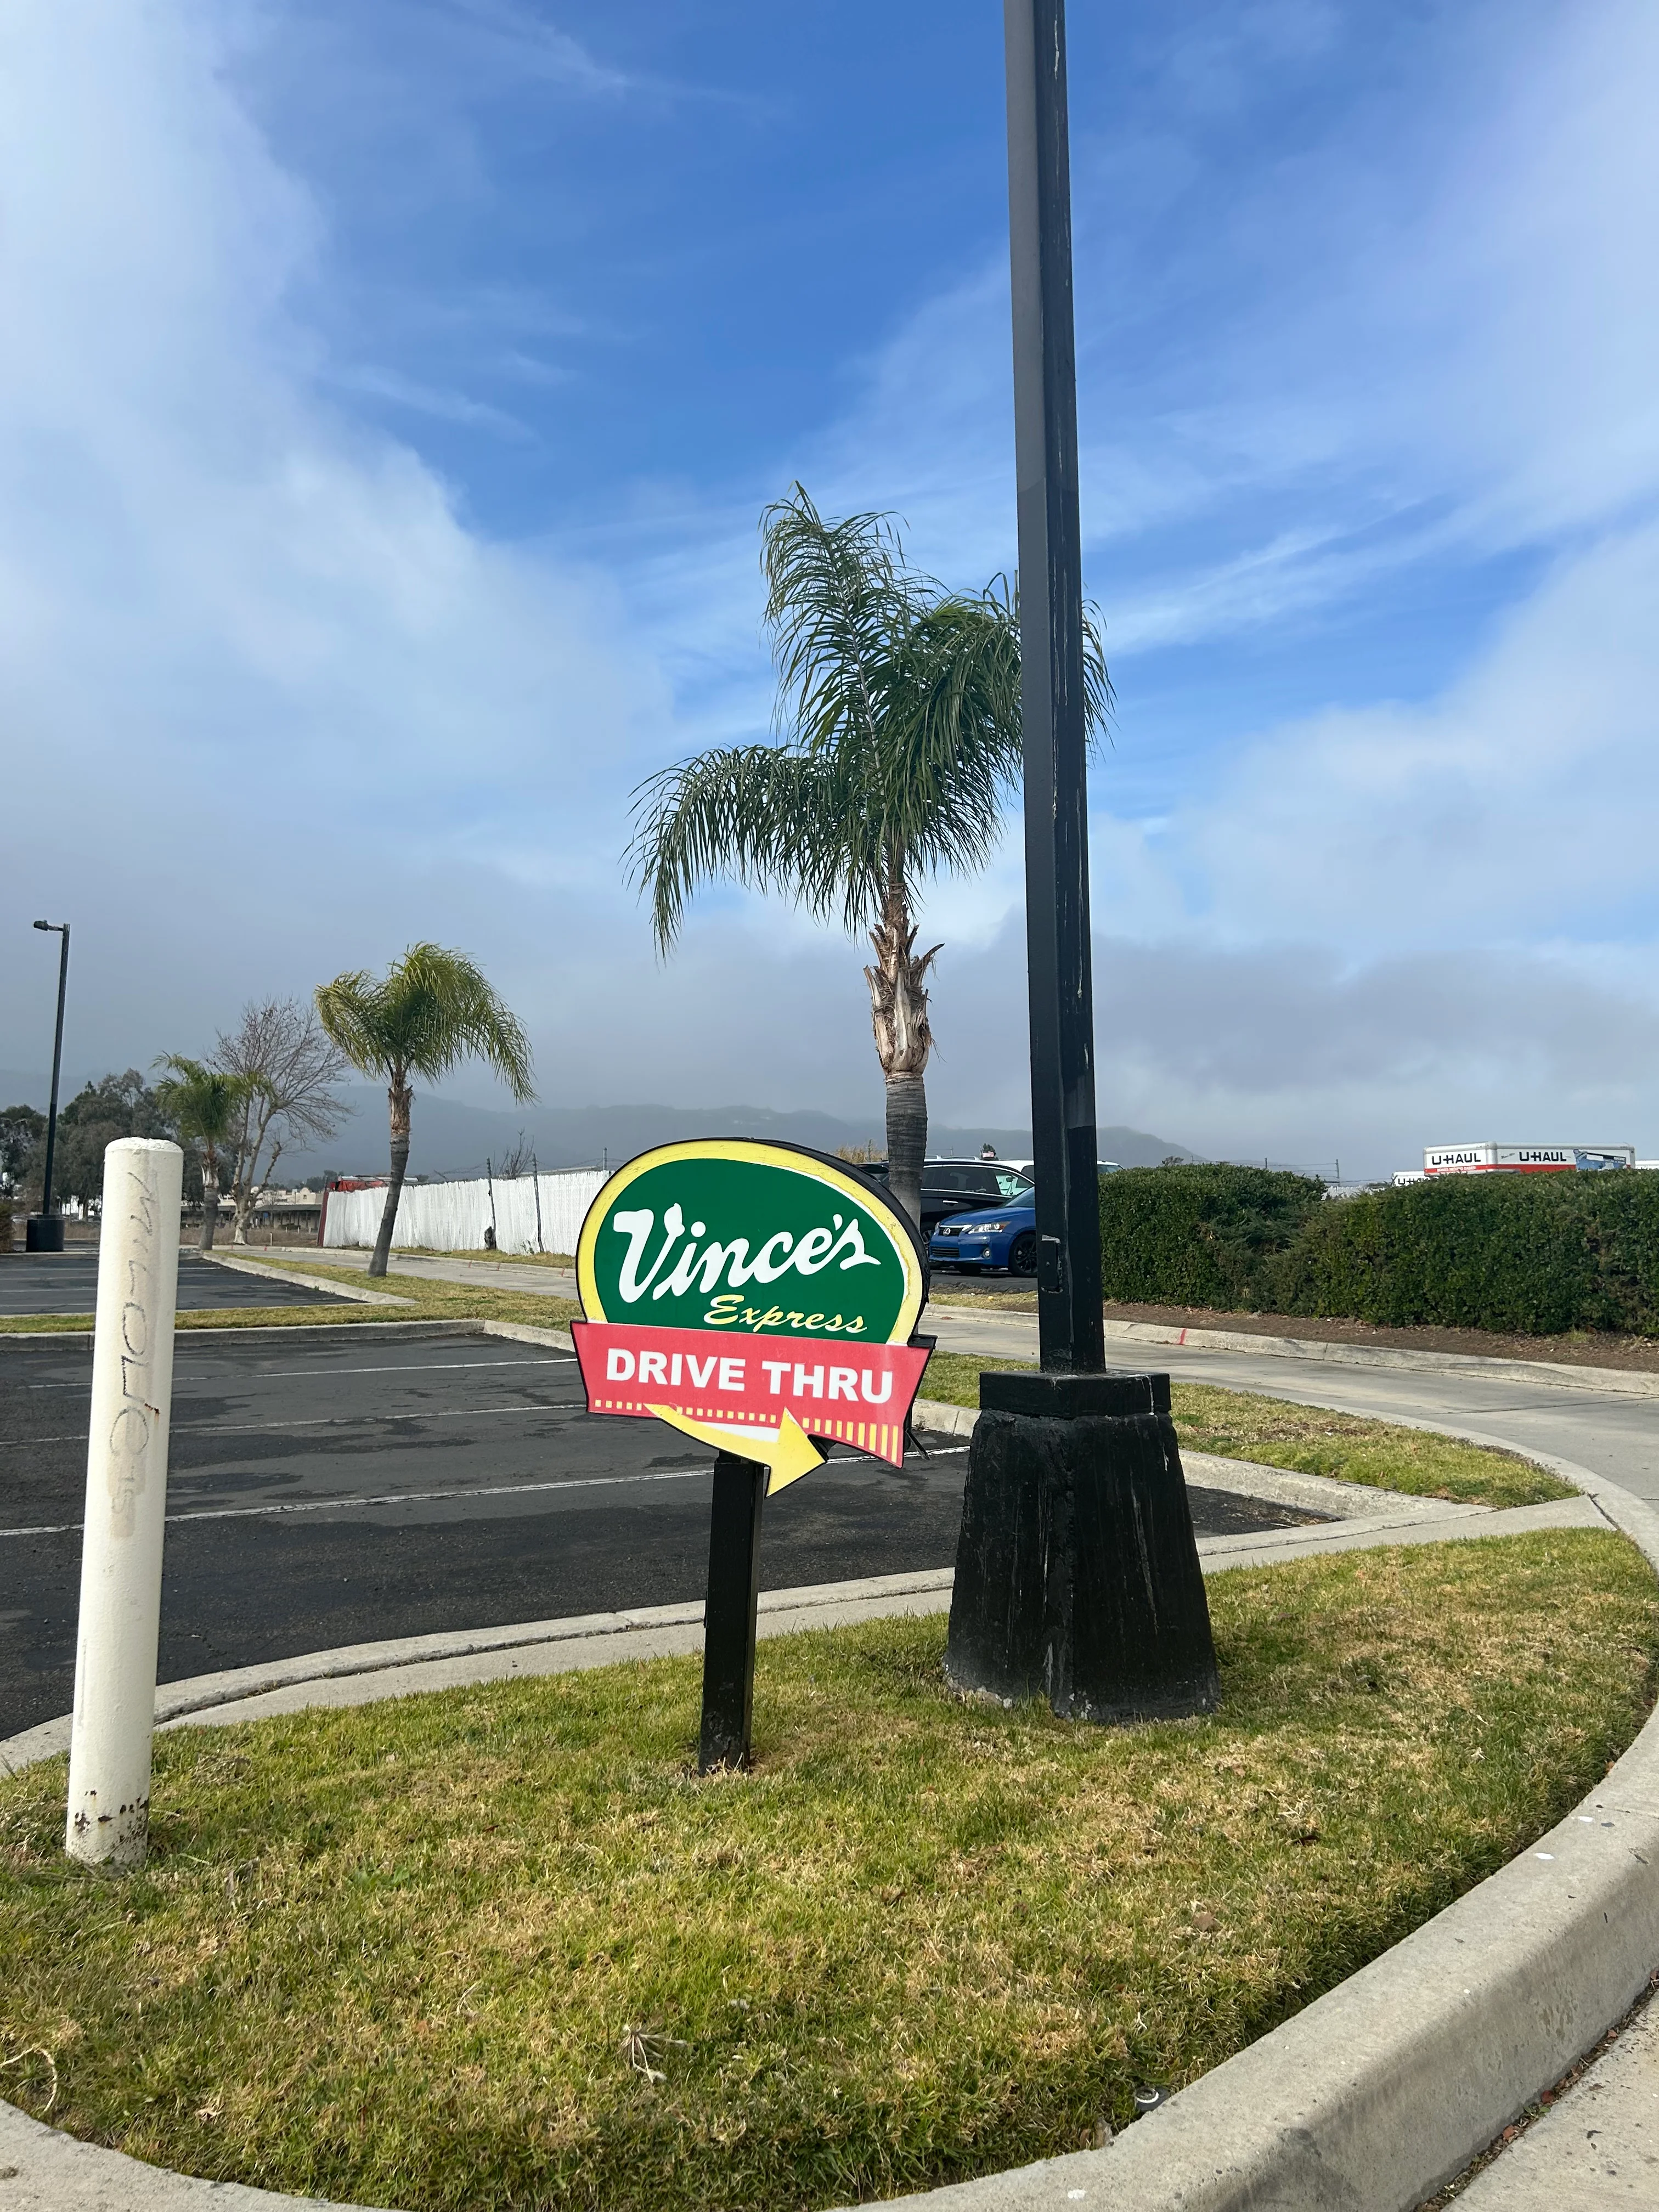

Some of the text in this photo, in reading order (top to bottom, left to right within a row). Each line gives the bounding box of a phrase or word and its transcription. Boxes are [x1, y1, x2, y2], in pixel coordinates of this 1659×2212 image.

[613, 1203, 882, 1304] Vince's
[703, 1294, 867, 1333] Express
[606, 1347, 893, 1404] DRIVE THRU
